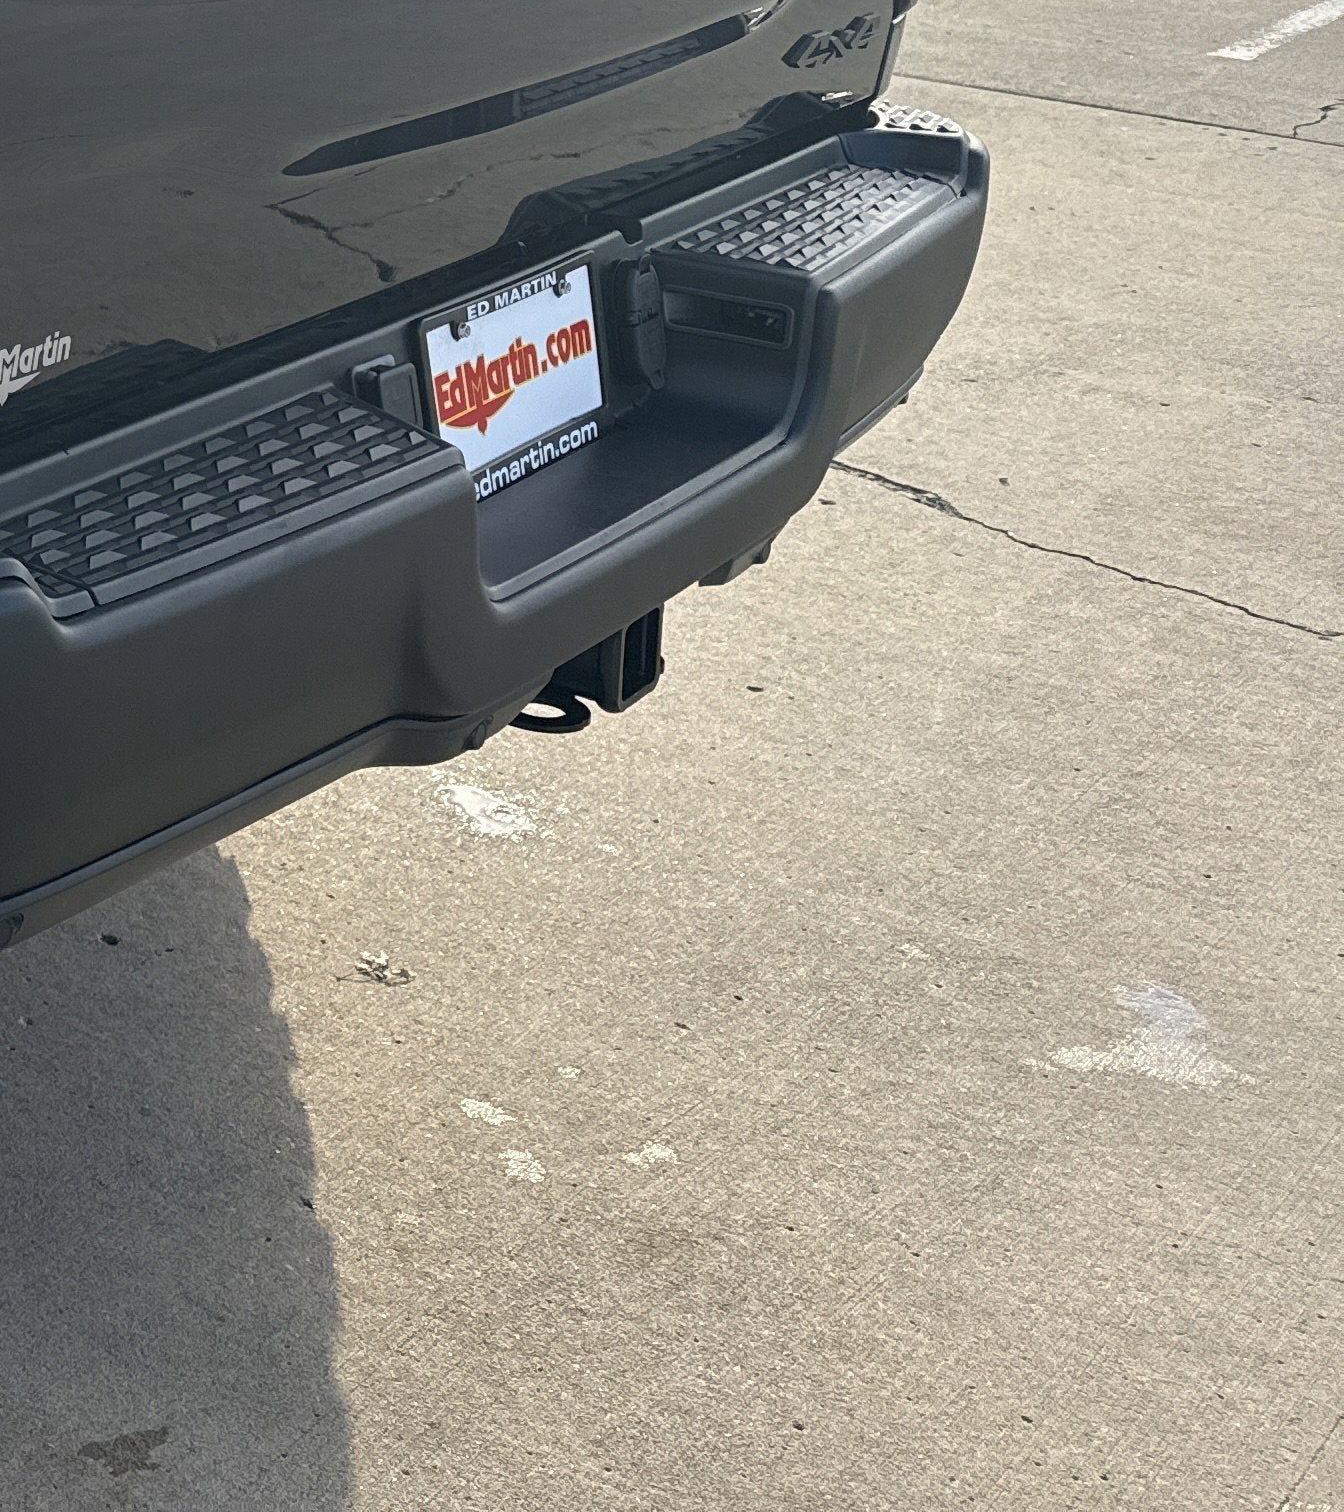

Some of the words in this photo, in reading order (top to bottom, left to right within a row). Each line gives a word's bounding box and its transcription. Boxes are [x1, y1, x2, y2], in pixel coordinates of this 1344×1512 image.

[466, 300, 490, 321] ED
[494, 270, 557, 311] MARTIN
[433, 319, 593, 425] EdMartin.com
